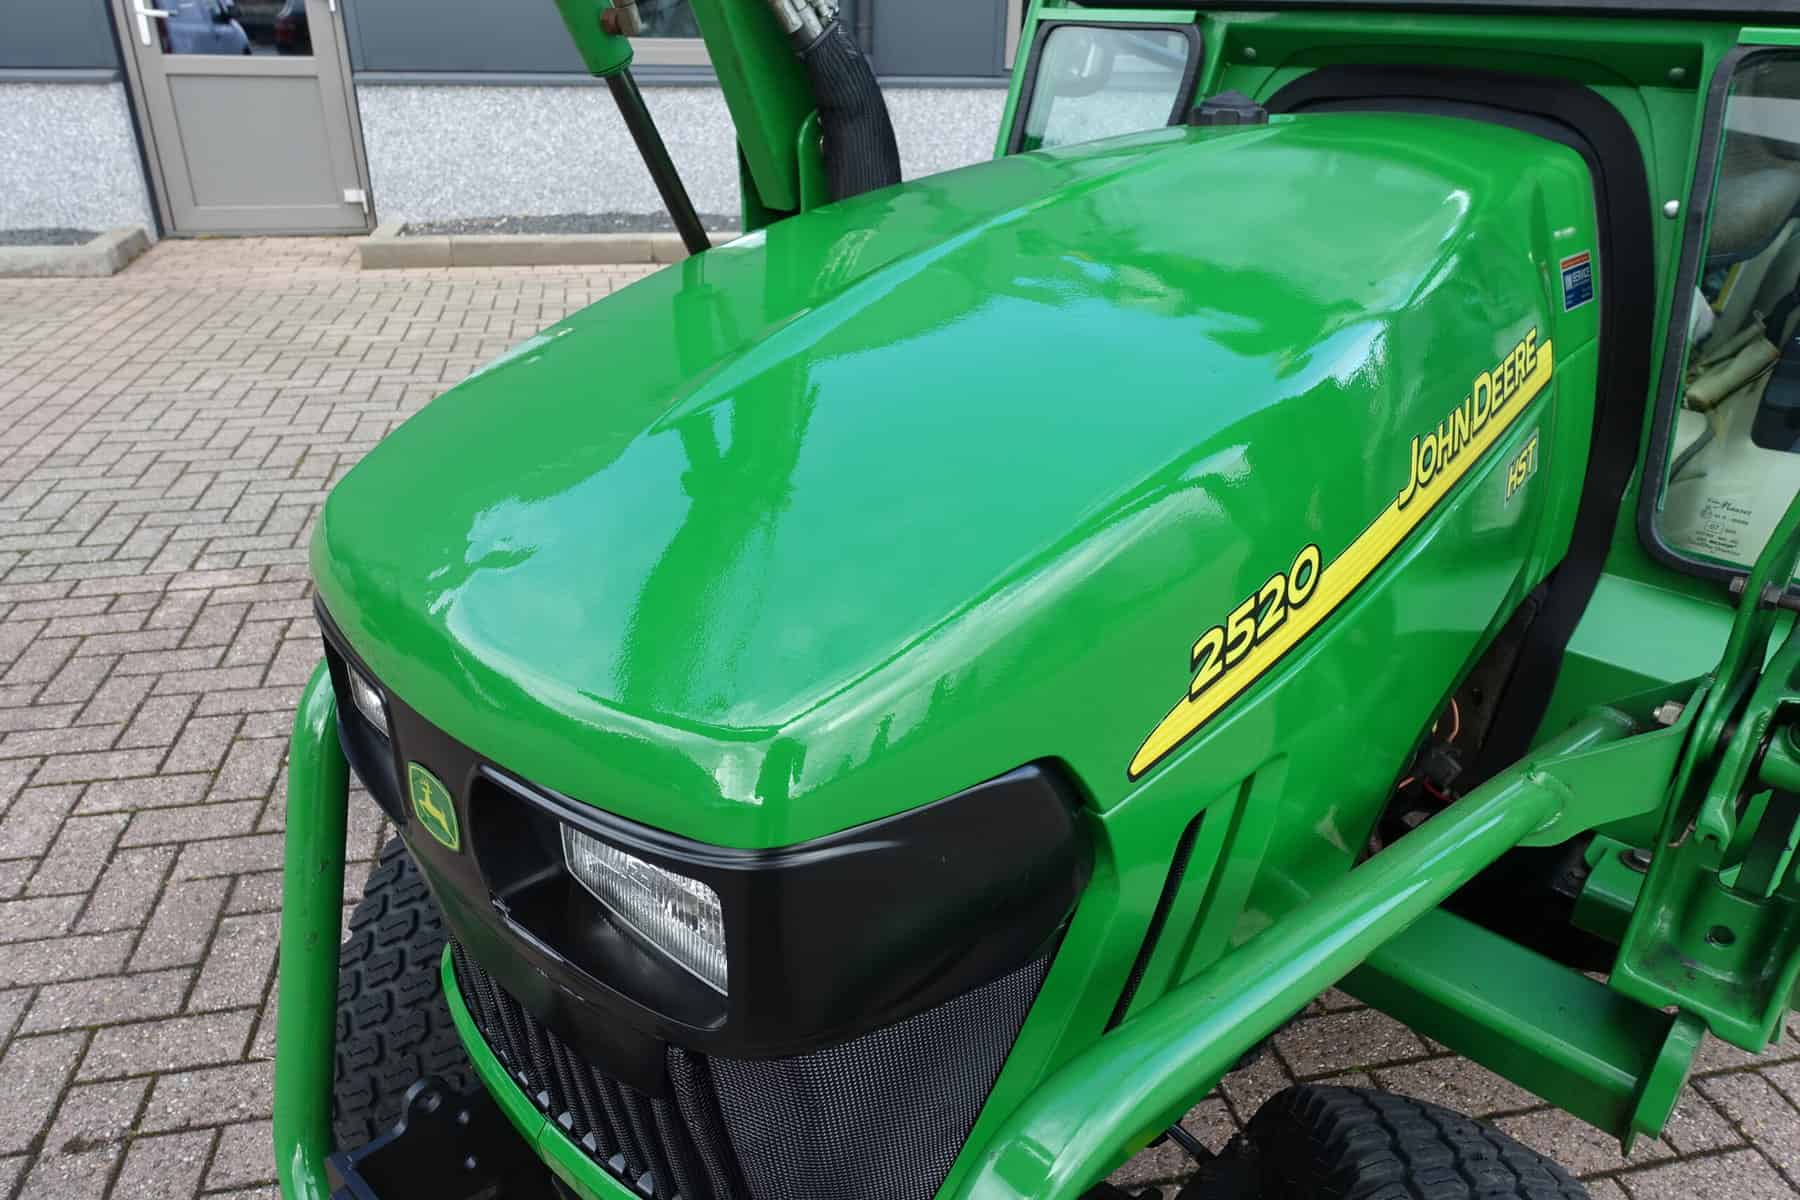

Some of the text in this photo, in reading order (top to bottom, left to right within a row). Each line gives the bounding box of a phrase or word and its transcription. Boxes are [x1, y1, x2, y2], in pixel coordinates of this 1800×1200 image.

[1398, 325, 1538, 509] JOHN DEERE
[1506, 436, 1537, 501] HST
[1189, 543, 1321, 702] 2520
